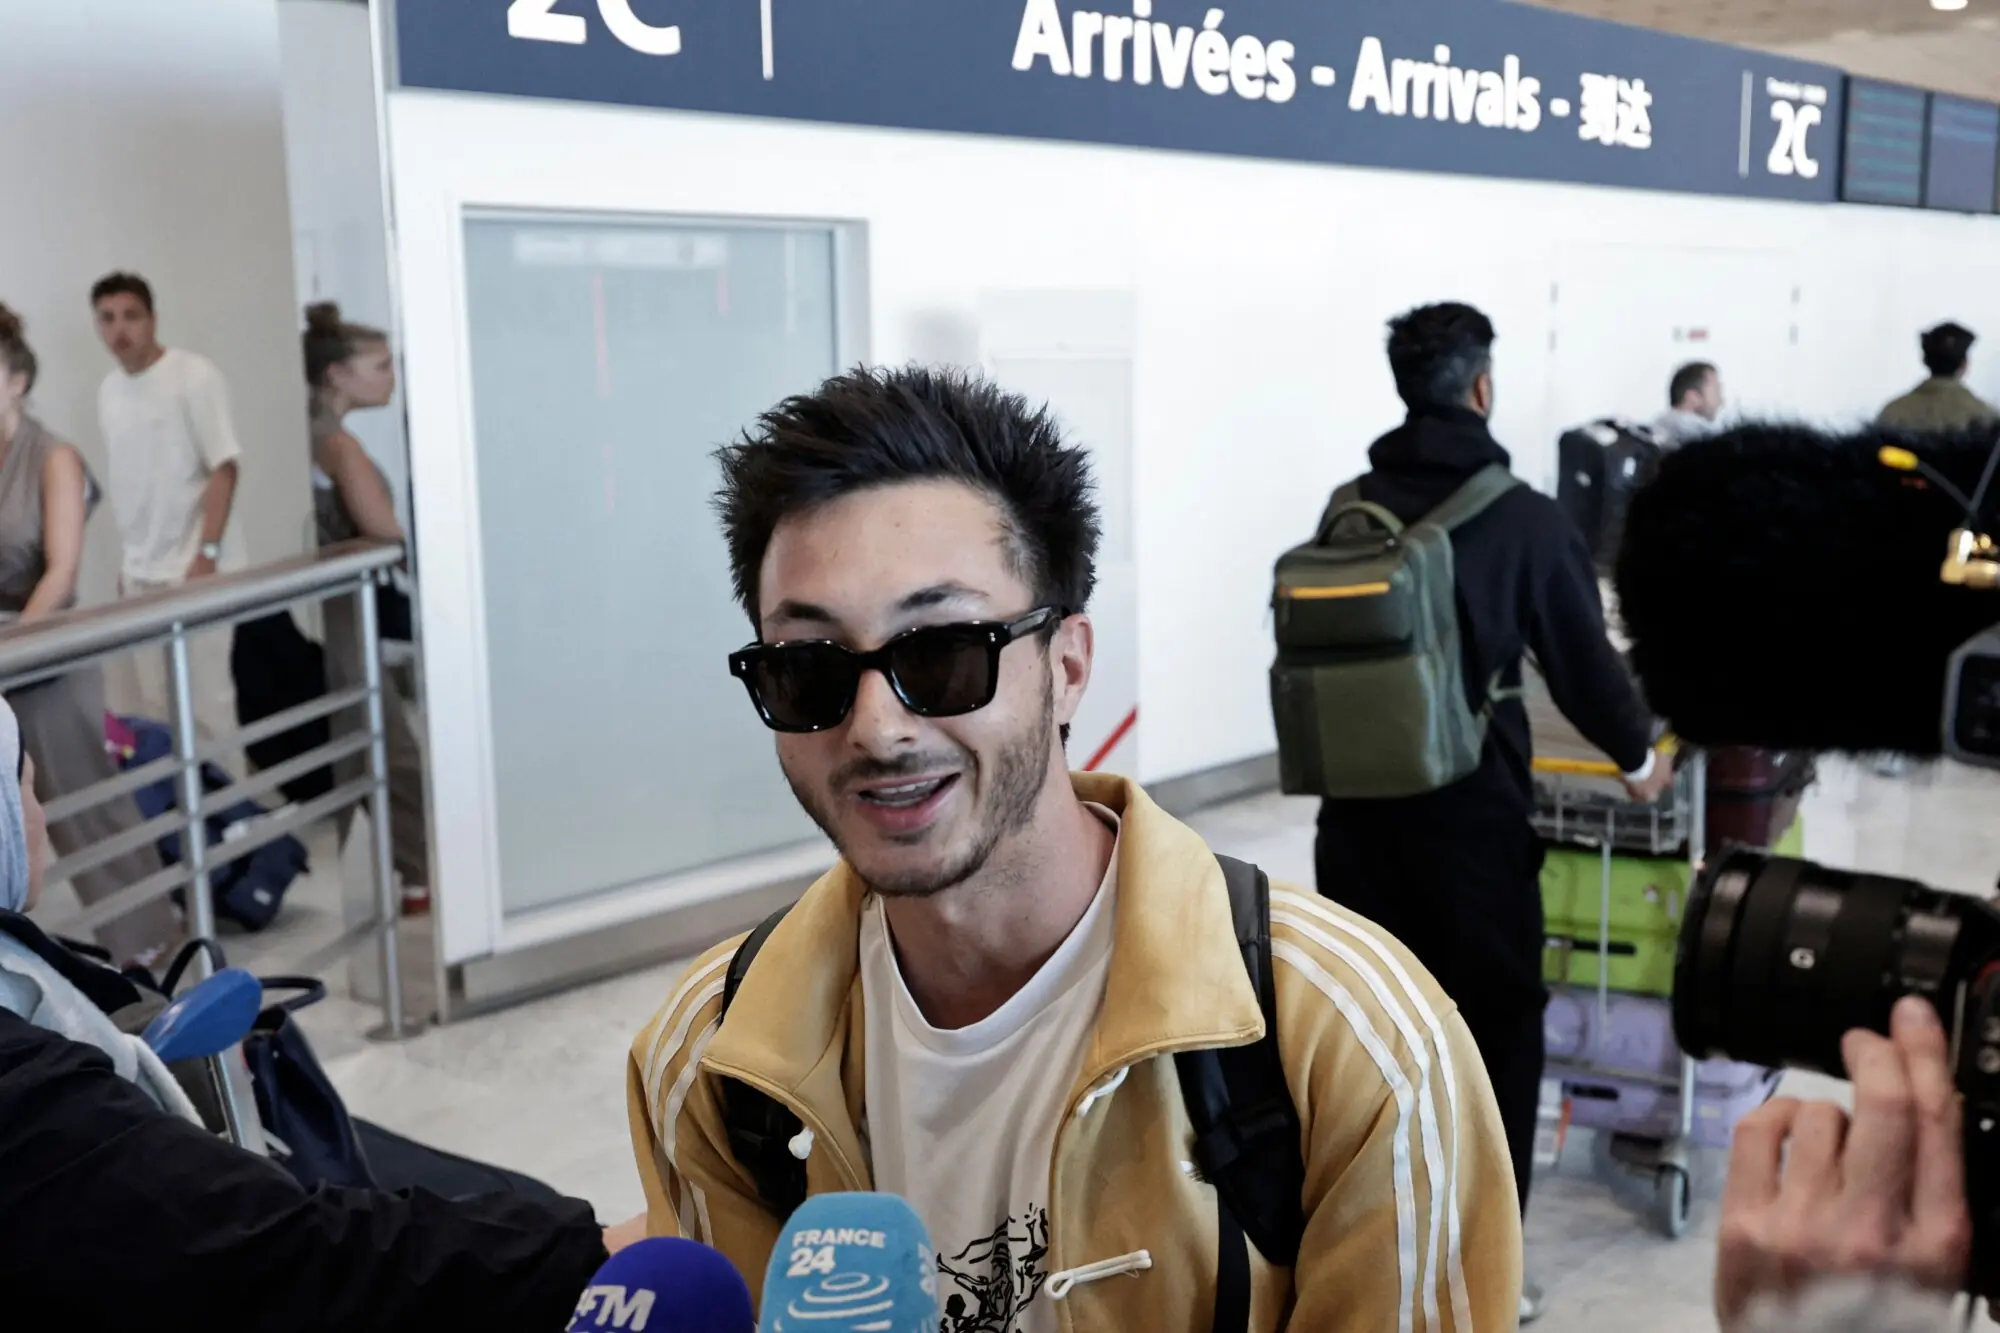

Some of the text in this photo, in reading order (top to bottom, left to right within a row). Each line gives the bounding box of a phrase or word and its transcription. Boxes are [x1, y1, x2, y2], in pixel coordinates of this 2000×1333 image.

[1011, 0, 1297, 103] Arrivées
[1347, 36, 1542, 132] Arrivals
[1767, 100, 1822, 178] 2C
[787, 1245, 836, 1278] 24
[793, 1227, 886, 1249] FRANCE
[565, 1284, 656, 1331] FM
